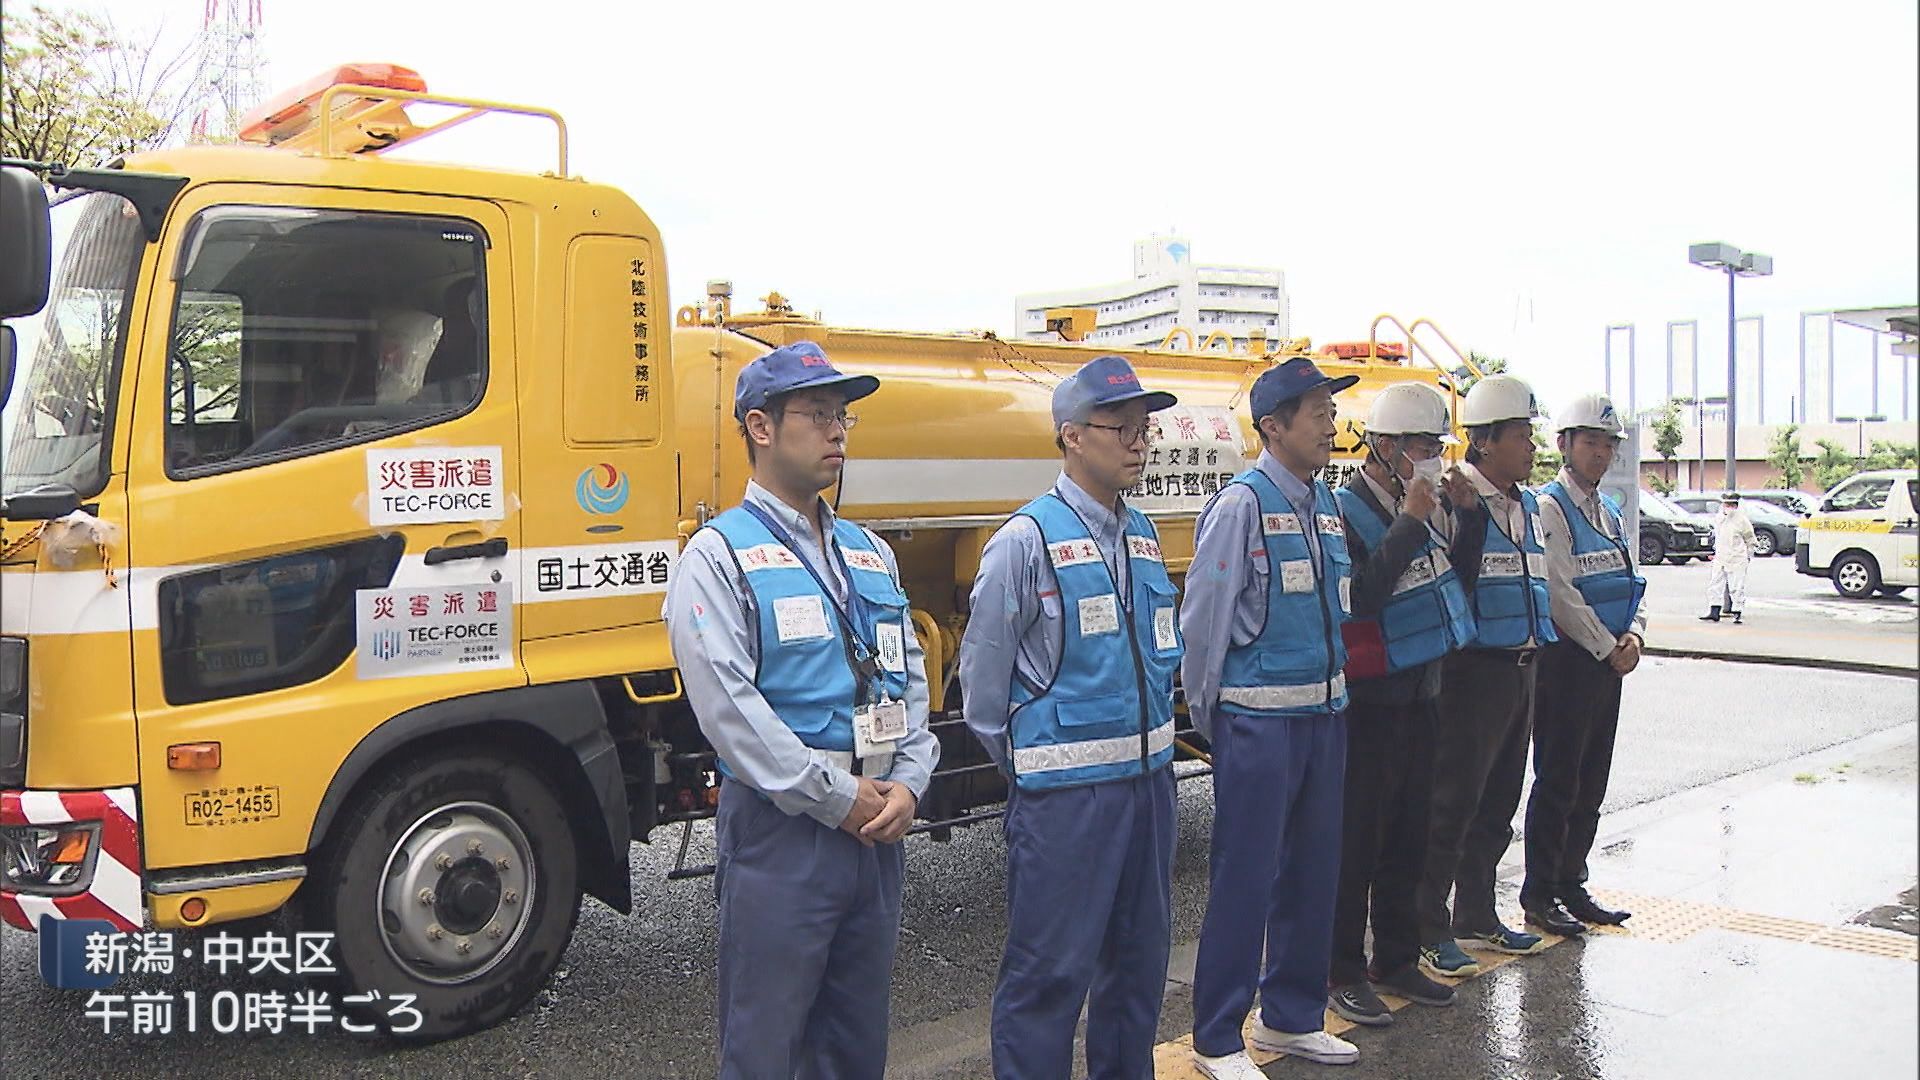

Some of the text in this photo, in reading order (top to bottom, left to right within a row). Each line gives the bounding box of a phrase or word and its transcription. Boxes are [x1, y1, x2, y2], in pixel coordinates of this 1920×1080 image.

[630, 258, 650, 402] 北陸技術事務所
[380, 458, 493, 490] 災害派遣
[382, 492, 492, 513] TEC-FORCE
[538, 551, 670, 592] 国土交通省
[373, 591, 498, 620] 災害派遣
[407, 622, 499, 642] TEC-FORCE
[192, 794, 273, 819] R02-1455
